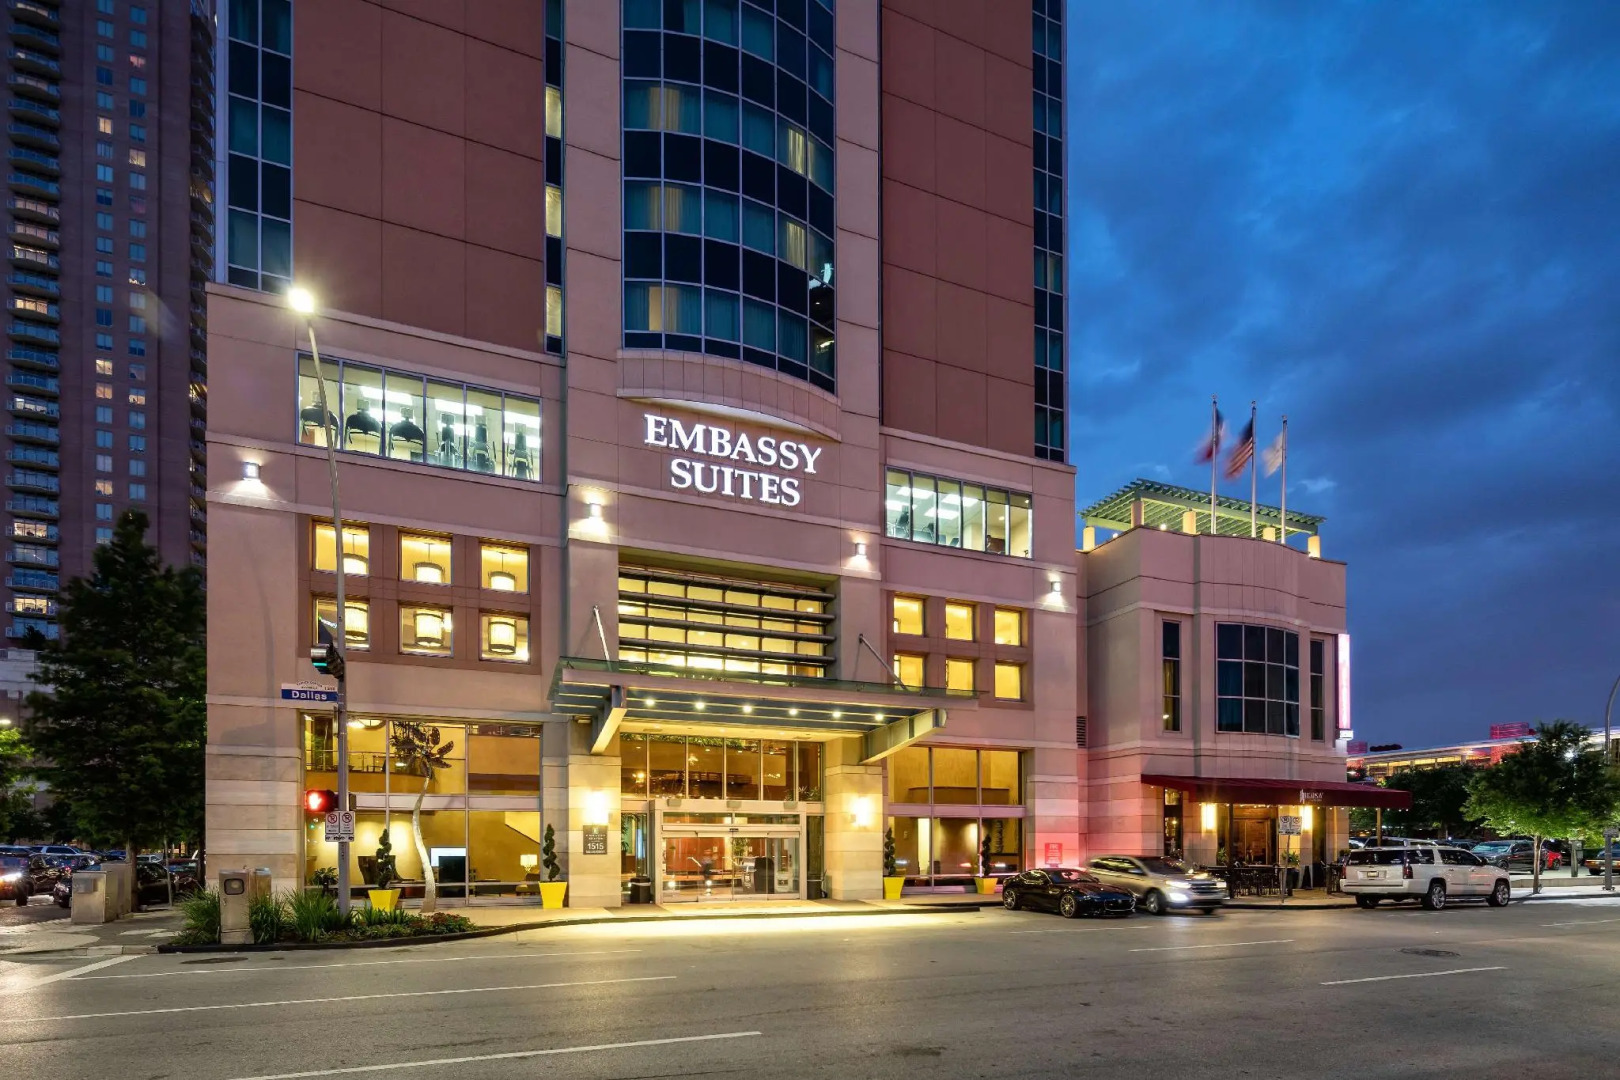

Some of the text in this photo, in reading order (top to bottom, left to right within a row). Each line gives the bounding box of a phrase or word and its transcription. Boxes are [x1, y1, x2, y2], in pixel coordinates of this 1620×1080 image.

[643, 413, 822, 474] EMBASSY
[670, 458, 801, 507] SUITES
[291, 690, 328, 700] Dallas
[587, 842, 604, 850] 1515
